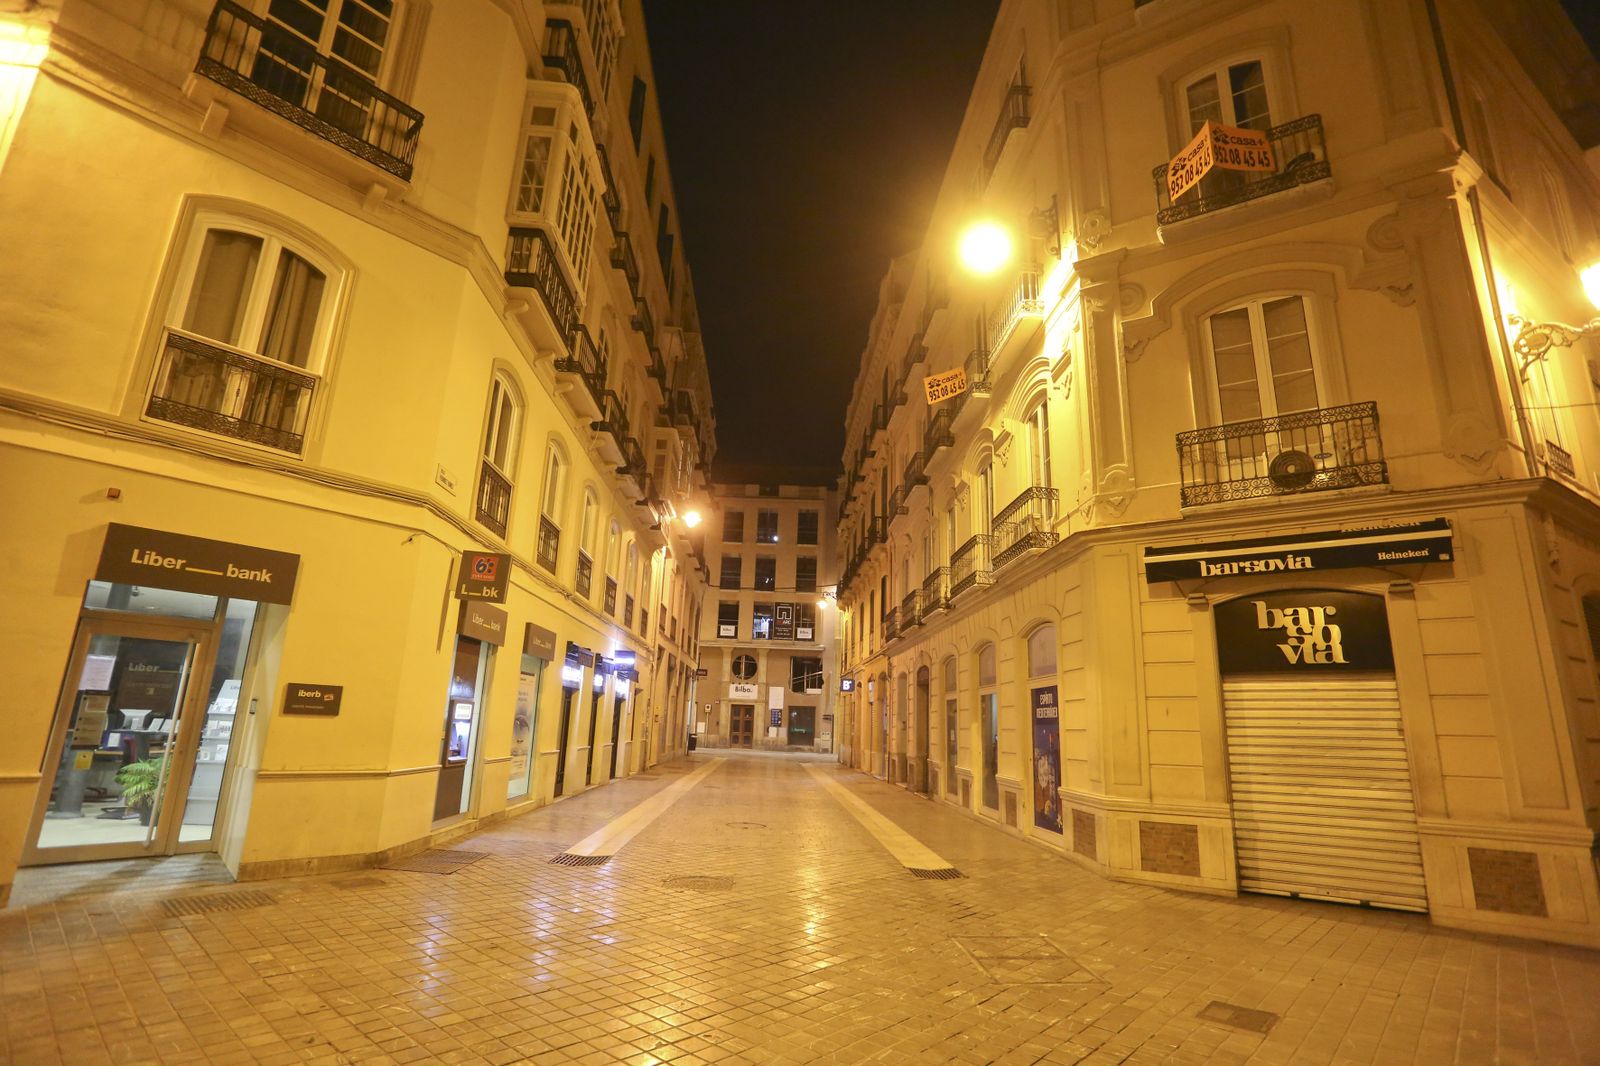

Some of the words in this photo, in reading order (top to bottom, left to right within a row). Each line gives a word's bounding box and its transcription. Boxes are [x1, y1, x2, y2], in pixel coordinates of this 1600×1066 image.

[1213, 144, 1229, 164] 952
[1229, 148, 1241, 165] 08
[1243, 150, 1256, 167] 45
[1257, 151, 1270, 168] 45
[1170, 174, 1184, 198] 952
[1184, 164, 1194, 185] 08
[1195, 156, 1203, 177] 45
[1204, 147, 1211, 167] 45
[928, 388, 940, 401] 952
[941, 384, 949, 397] 08
[949, 382, 957, 393] 45
[958, 378, 965, 390] 45
[130, 548, 187, 570] Liber
[226, 563, 273, 583] bank
[1197, 554, 1315, 577] barsovia
[1377, 549, 1429, 561] Heineken
[1250, 600, 1337, 629] bar
